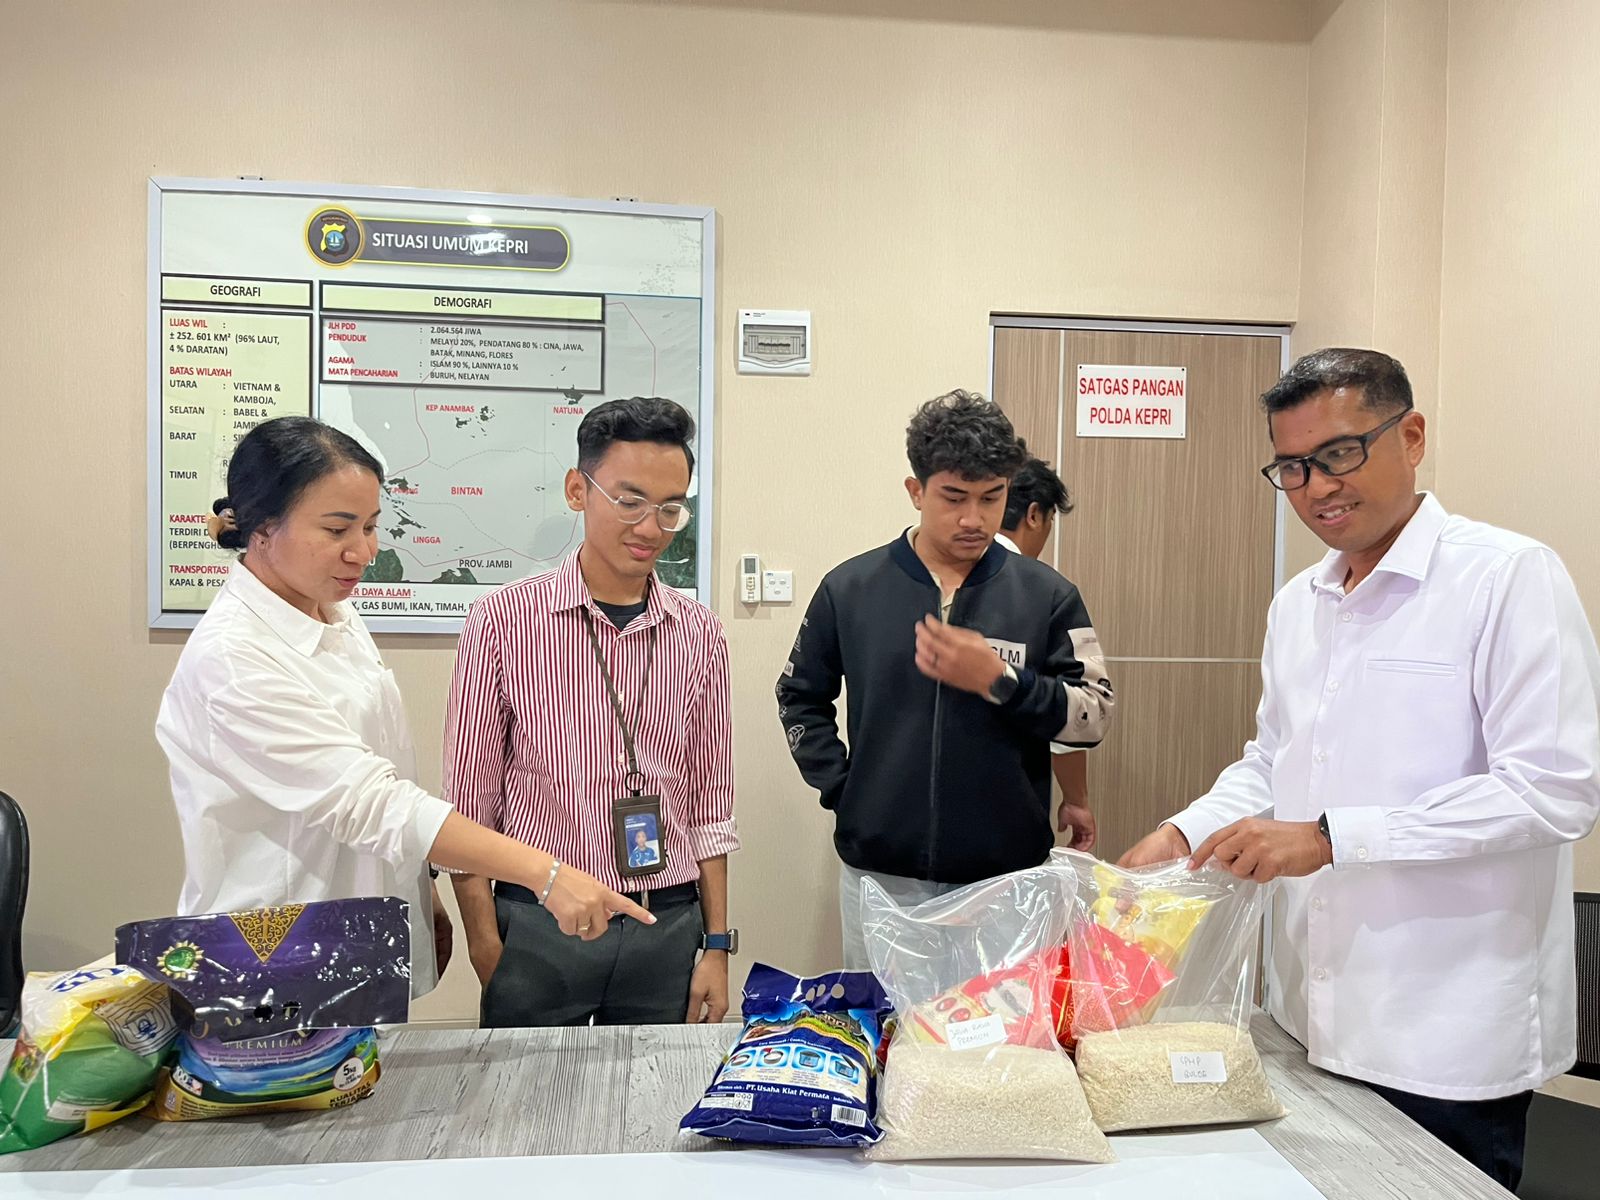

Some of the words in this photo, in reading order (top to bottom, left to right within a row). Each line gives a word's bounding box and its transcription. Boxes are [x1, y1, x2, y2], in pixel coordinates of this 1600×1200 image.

[372, 233, 428, 249] SITUASI
[432, 234, 485, 252] UMUM
[488, 237, 529, 254] KEPRI
[210, 285, 261, 297] GEOGRAFI
[434, 297, 492, 308] DEMOGRAFI
[170, 318, 190, 328] LUAS
[191, 318, 208, 328] WIL
[328, 322, 339, 330] JLH
[341, 322, 356, 330] PDD
[430, 326, 463, 335] 2.064.564
[177, 333, 194, 341] 252.
[196, 333, 211, 341] 601
[235, 334, 255, 344] (96%
[257, 336, 280, 345] LAUT,
[328, 333, 367, 342] PENDUDUK
[430, 338, 459, 346] MELAYU
[460, 339, 476, 347] 20%,
[479, 340, 521, 348] PENDATANG
[522, 341, 531, 349] 80
[543, 343, 561, 351] CINA,
[169, 344, 175, 352] 4
[186, 345, 228, 356] DARATAN)
[456, 350, 488, 359] MINANG,
[328, 356, 355, 365] AGAMA
[471, 362, 502, 370] LAINNYA
[170, 367, 194, 375] BATAS
[196, 367, 232, 377] WILAYAH
[328, 368, 349, 376] MATA
[350, 368, 398, 378] PENCAHARIAN
[430, 372, 457, 380] BURUH,
[458, 373, 489, 381] NELAYAN
[170, 380, 197, 389] UTARA
[233, 382, 272, 391] VIETNAM
[274, 383, 281, 392] &
[1079, 377, 1129, 395] SATGAS
[1132, 379, 1183, 397] PANGAN
[233, 396, 276, 406] KAMBOJA,
[170, 406, 205, 415] SELATAN
[233, 408, 259, 417] BABEL
[261, 409, 268, 418] &
[553, 406, 584, 415] NATUNA
[1090, 407, 1131, 424] POLDA
[1135, 408, 1171, 425] KEPRI
[170, 432, 196, 440] BARAT
[170, 471, 197, 479] TIMUR
[451, 487, 483, 496] BINTAN
[169, 515, 207, 524] KARAKTE
[169, 528, 201, 536] TERDIRI
[413, 536, 441, 544] LINGGA
[459, 559, 484, 568] PROV.
[486, 560, 512, 568] JAMBI
[169, 565, 229, 574] TRANSPORTASI
[169, 579, 195, 587] KAPAL
[197, 579, 204, 587] &
[361, 588, 384, 597] DAYA
[386, 588, 411, 597] ALAM
[361, 601, 379, 610] GAS
[382, 602, 408, 612] BUMI,
[410, 603, 433, 612] IKAN,
[436, 603, 466, 613] TIMAH,
[224, 1037, 303, 1050] PREMIUM
[329, 1081, 371, 1104] KUALITAS
[782, 1086, 797, 1096] Kiat
[799, 1089, 830, 1101] Permata
